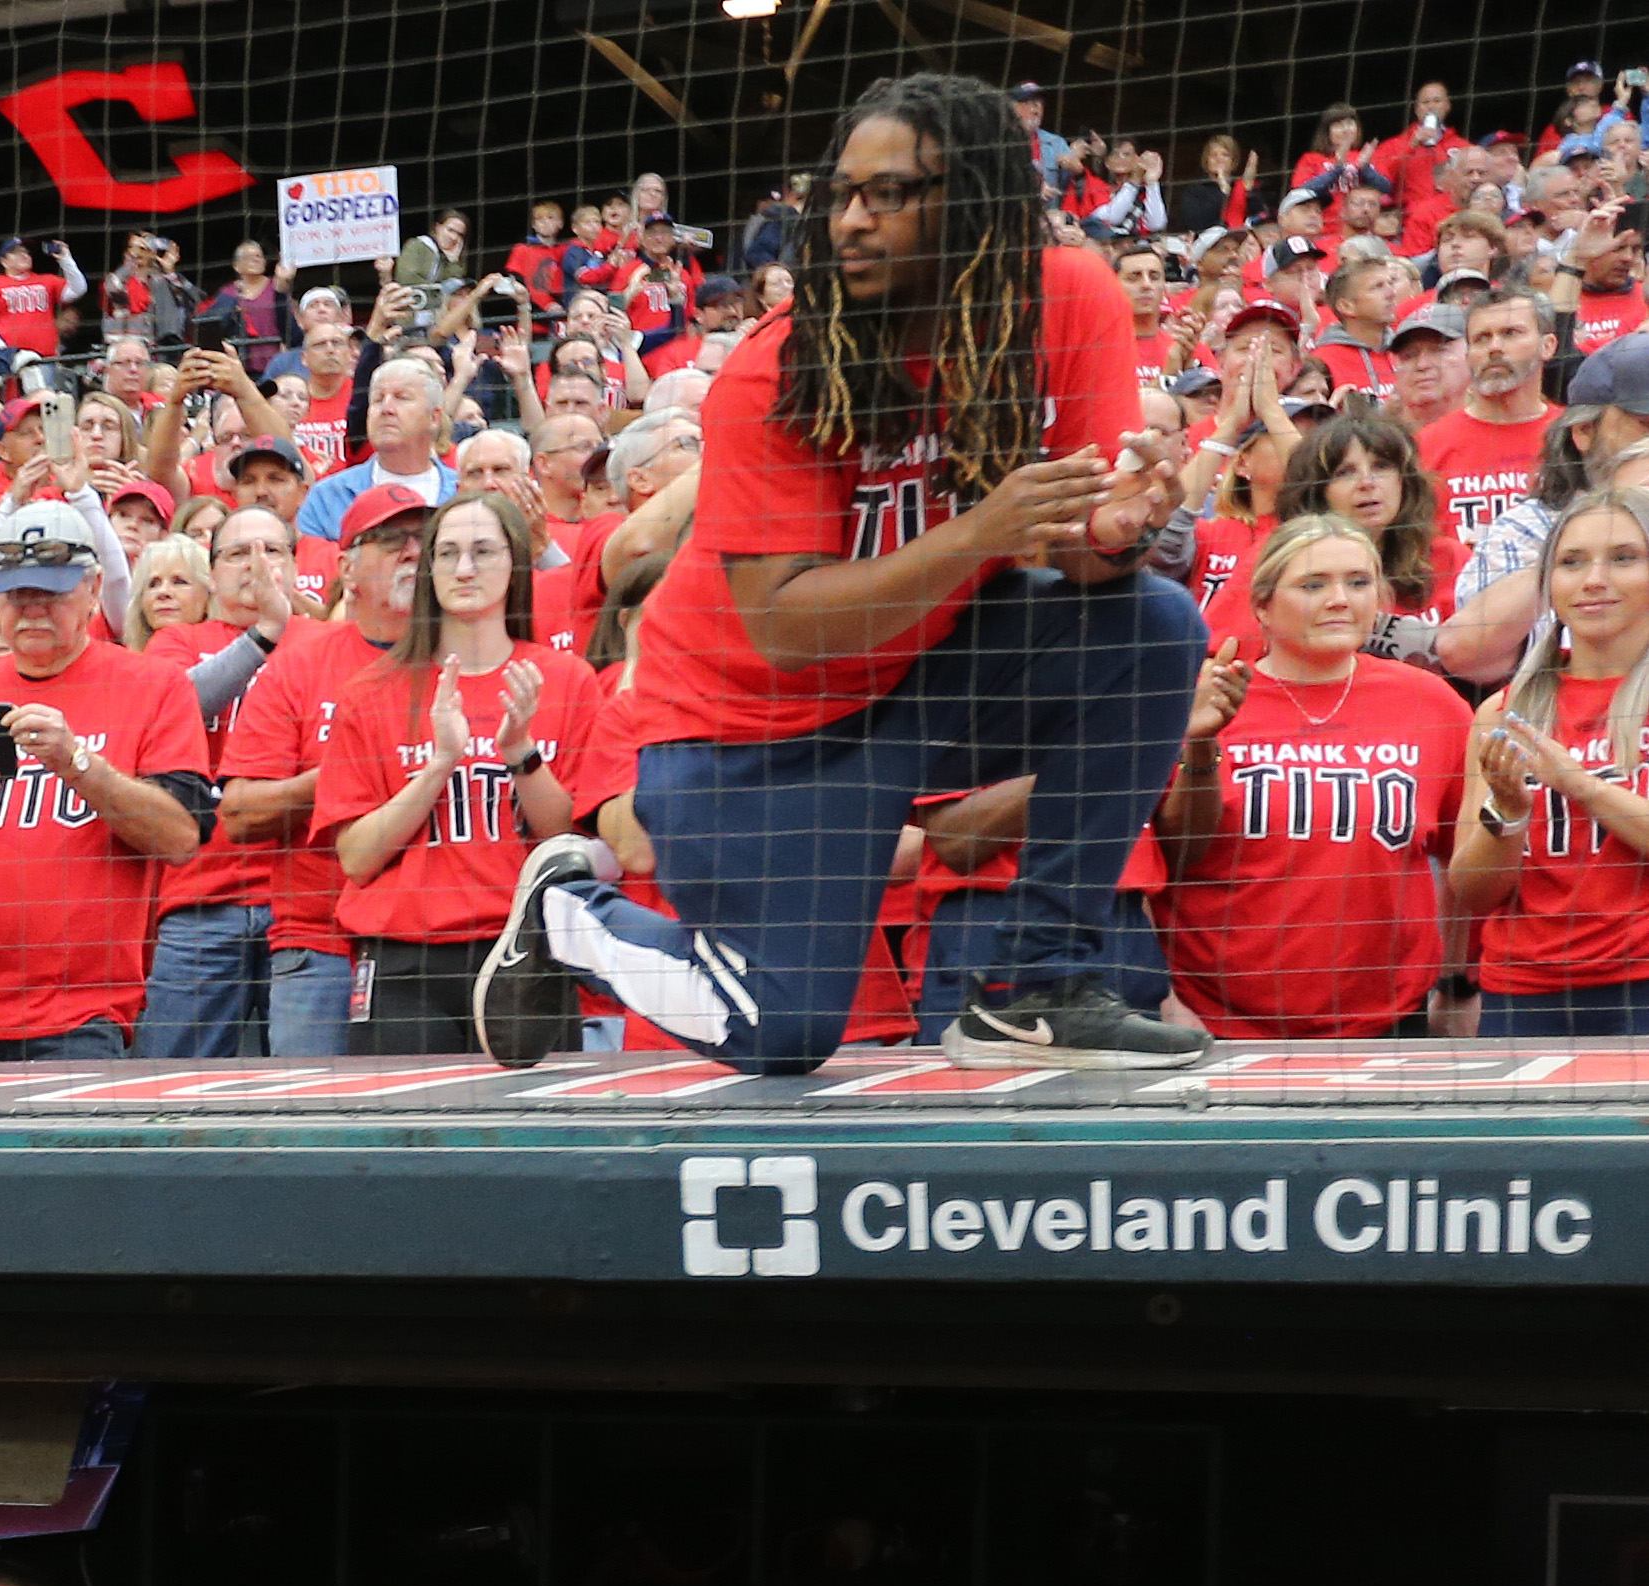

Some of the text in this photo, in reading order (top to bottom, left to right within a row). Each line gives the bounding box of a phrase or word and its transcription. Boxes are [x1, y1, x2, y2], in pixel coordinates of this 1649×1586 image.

[285, 194, 399, 226] GODSPEED
[1448, 473, 1529, 494] THANK
[1226, 744, 1420, 768] THANK YOU
[1232, 762, 1418, 851] TITO
[841, 1177, 1594, 1256] Cleveland Clinic
